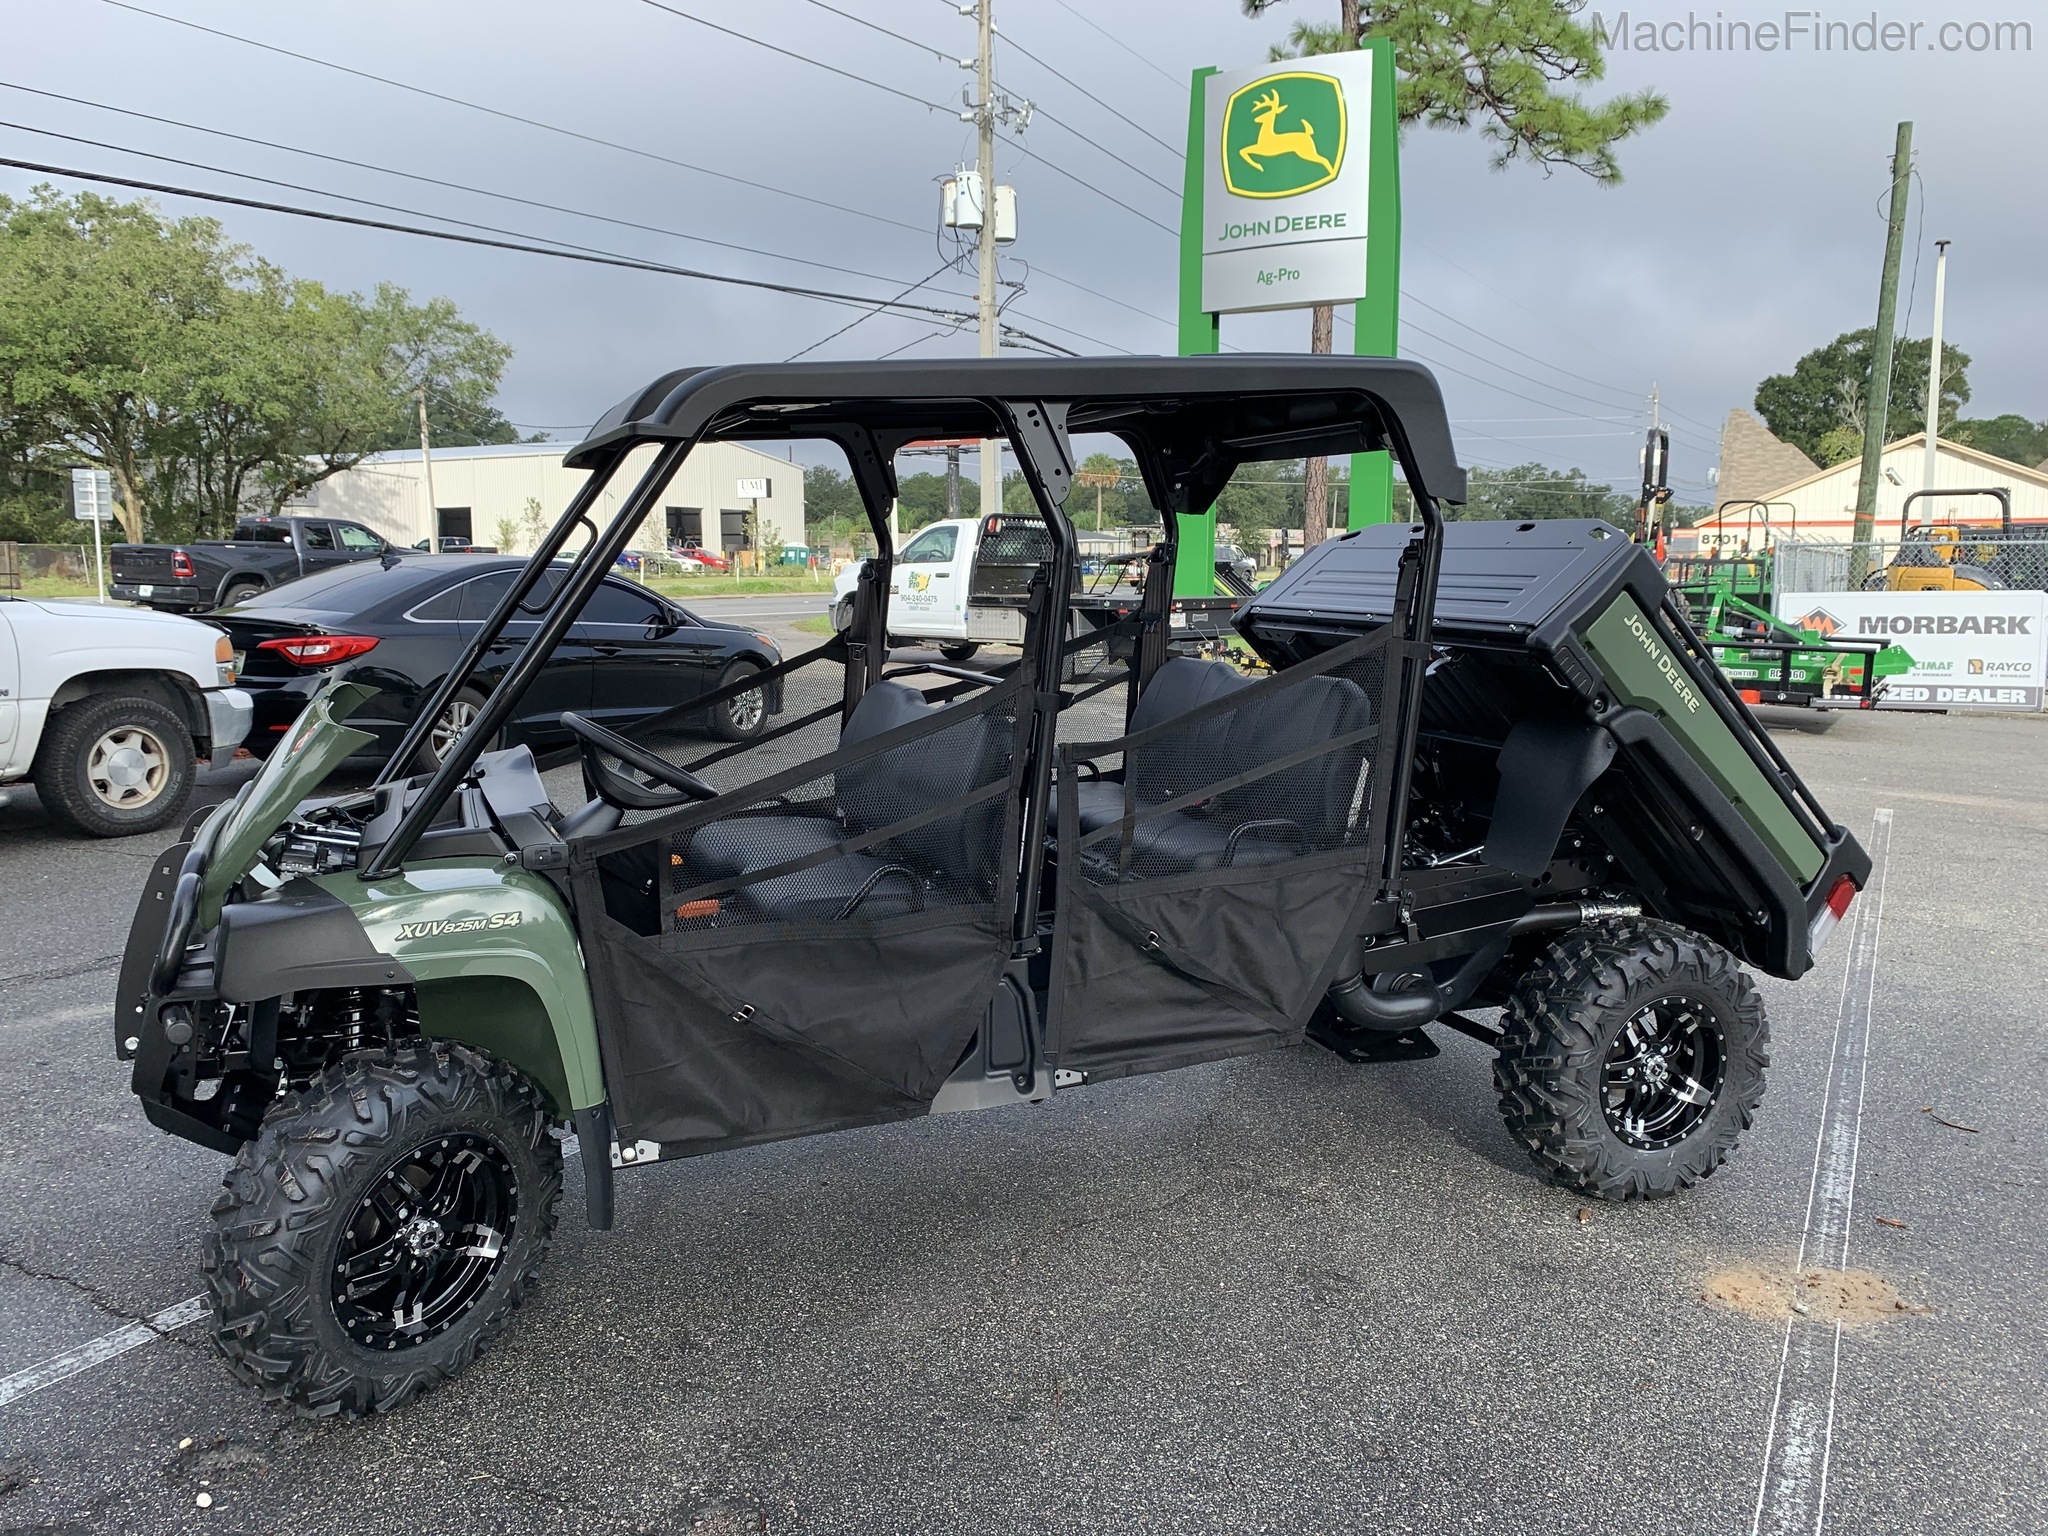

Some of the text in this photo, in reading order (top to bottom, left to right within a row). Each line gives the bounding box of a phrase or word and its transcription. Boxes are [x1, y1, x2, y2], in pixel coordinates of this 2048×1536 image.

[1218, 212, 1347, 241] JOHN DEERE
[1256, 267, 1301, 286] Ag-Pro
[1701, 534, 1739, 545] 8701
[1858, 615, 2032, 635] MORBARK
[1624, 613, 1701, 714] JOHN DEERE
[1914, 661, 1954, 671] CIMAF
[1985, 662, 2032, 672] RAYCO
[1936, 687, 2027, 704] DEALER
[396, 911, 521, 940] XUV825M S4
